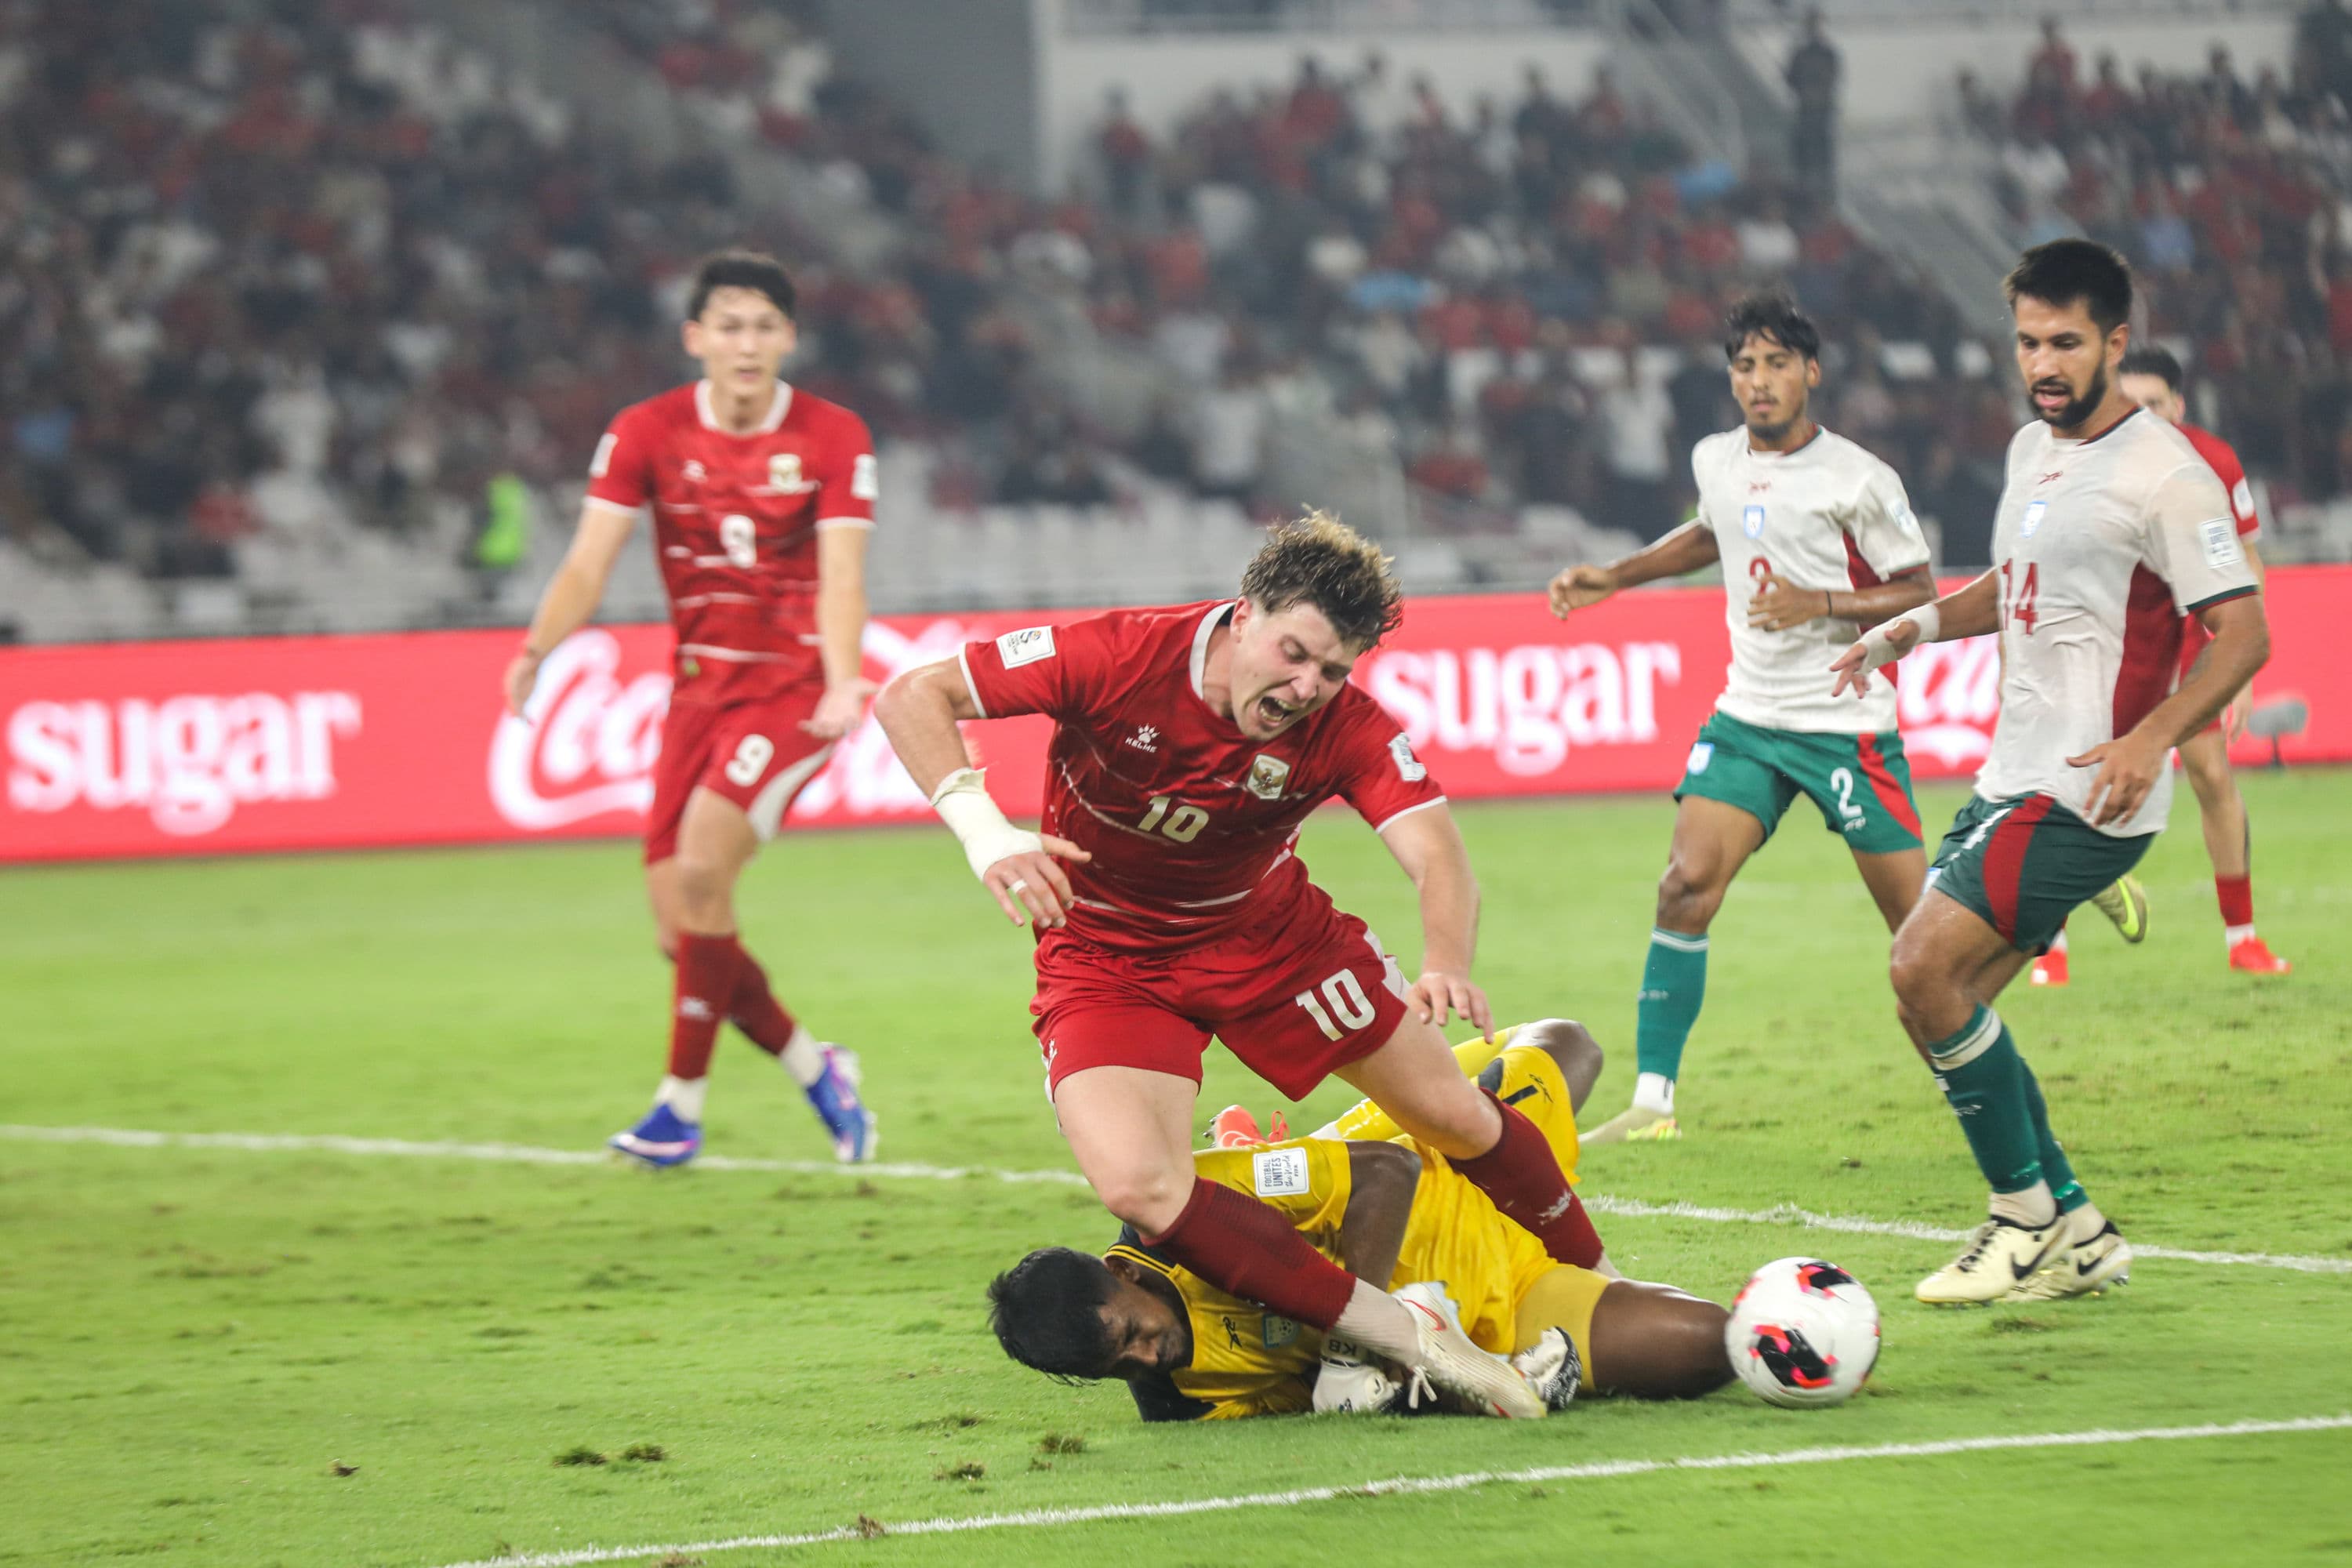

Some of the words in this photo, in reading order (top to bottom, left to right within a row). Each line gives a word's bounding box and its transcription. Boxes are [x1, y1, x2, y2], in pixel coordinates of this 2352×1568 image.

[720, 514, 756, 568] 9
[2002, 557, 2038, 634] 14
[1369, 641, 1681, 777] sugar
[8, 691, 362, 837] sugar
[725, 734, 774, 786] 9
[1125, 736, 1158, 753] KELME
[1831, 767, 1862, 819] 2
[1137, 795, 1209, 844] 10
[1296, 968, 1376, 1041] 10
[1263, 1159, 1272, 1187] FOOTBALL
[1272, 1157, 1283, 1187] UNITES
[1282, 1155, 1293, 1174] World
[1284, 1175, 1294, 1187] the
[1329, 1339, 1356, 1357] KB
